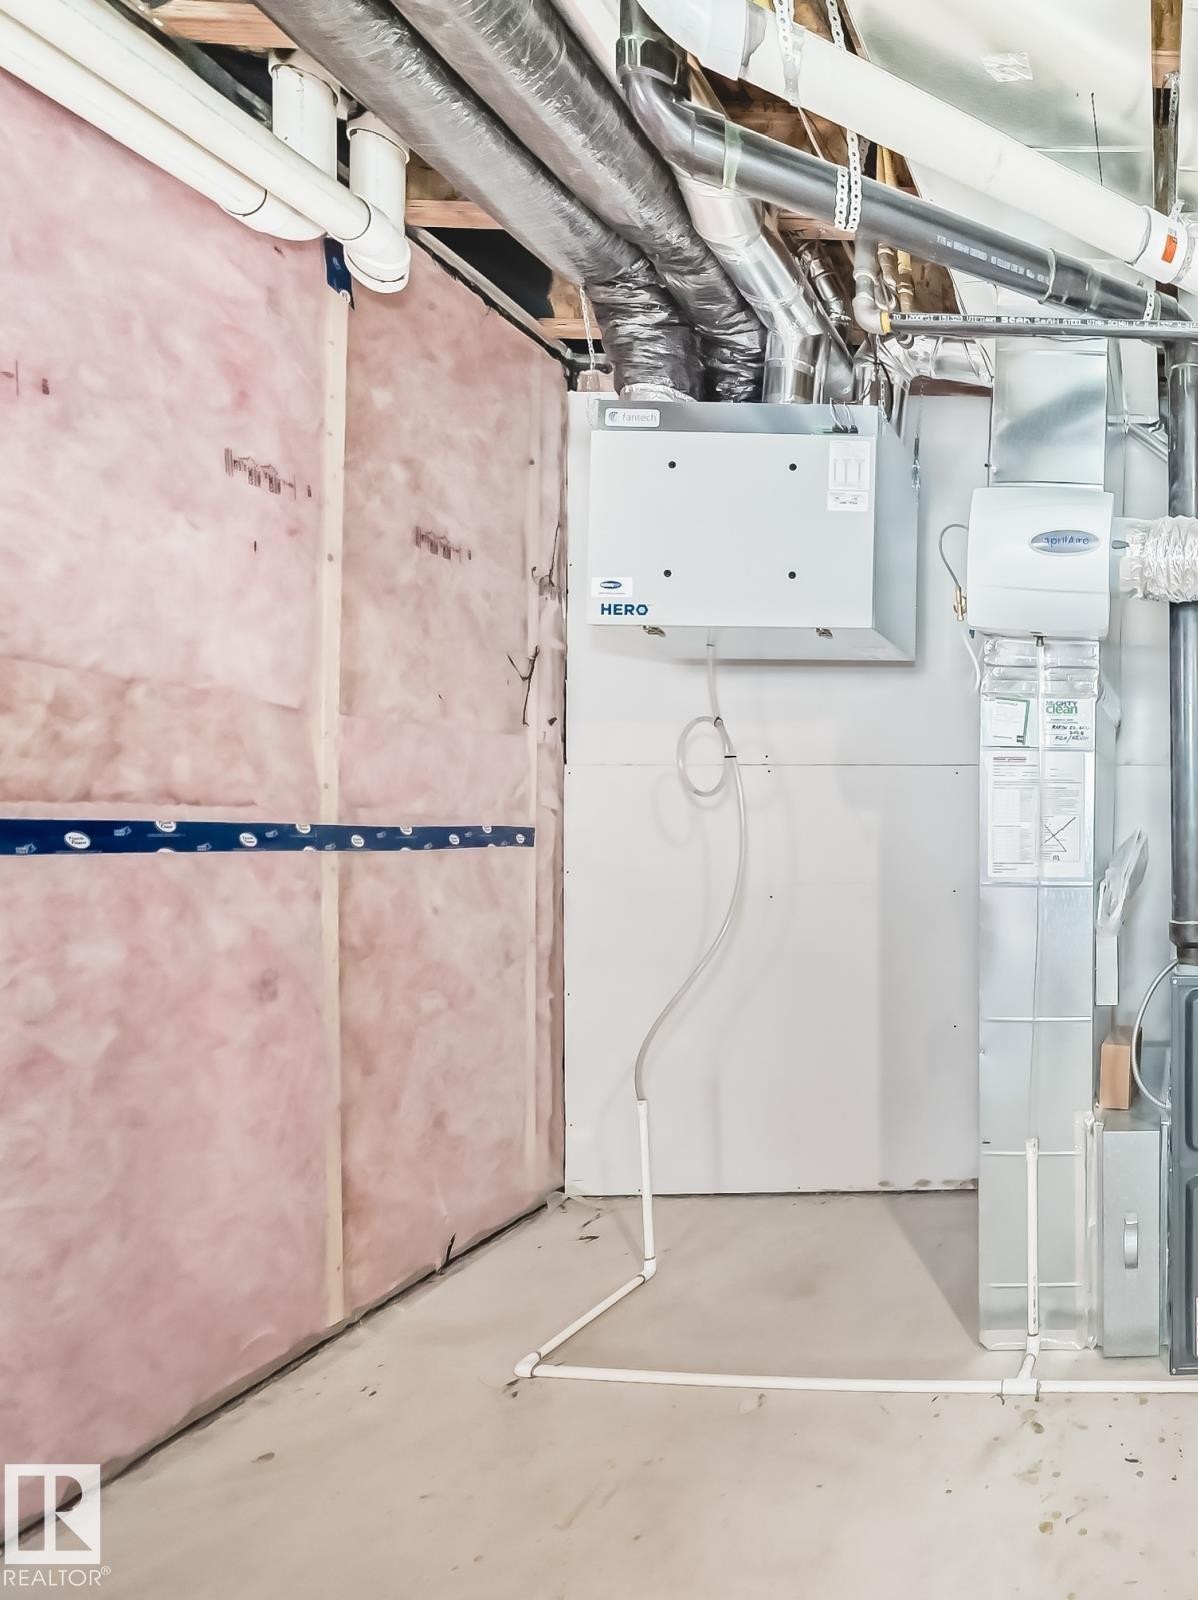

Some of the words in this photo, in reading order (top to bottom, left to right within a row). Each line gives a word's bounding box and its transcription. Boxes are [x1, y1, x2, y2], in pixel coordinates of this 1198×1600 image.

[622, 411, 657, 422] fantech
[600, 603, 649, 616] HERO
[1045, 703, 1078, 714] clean
